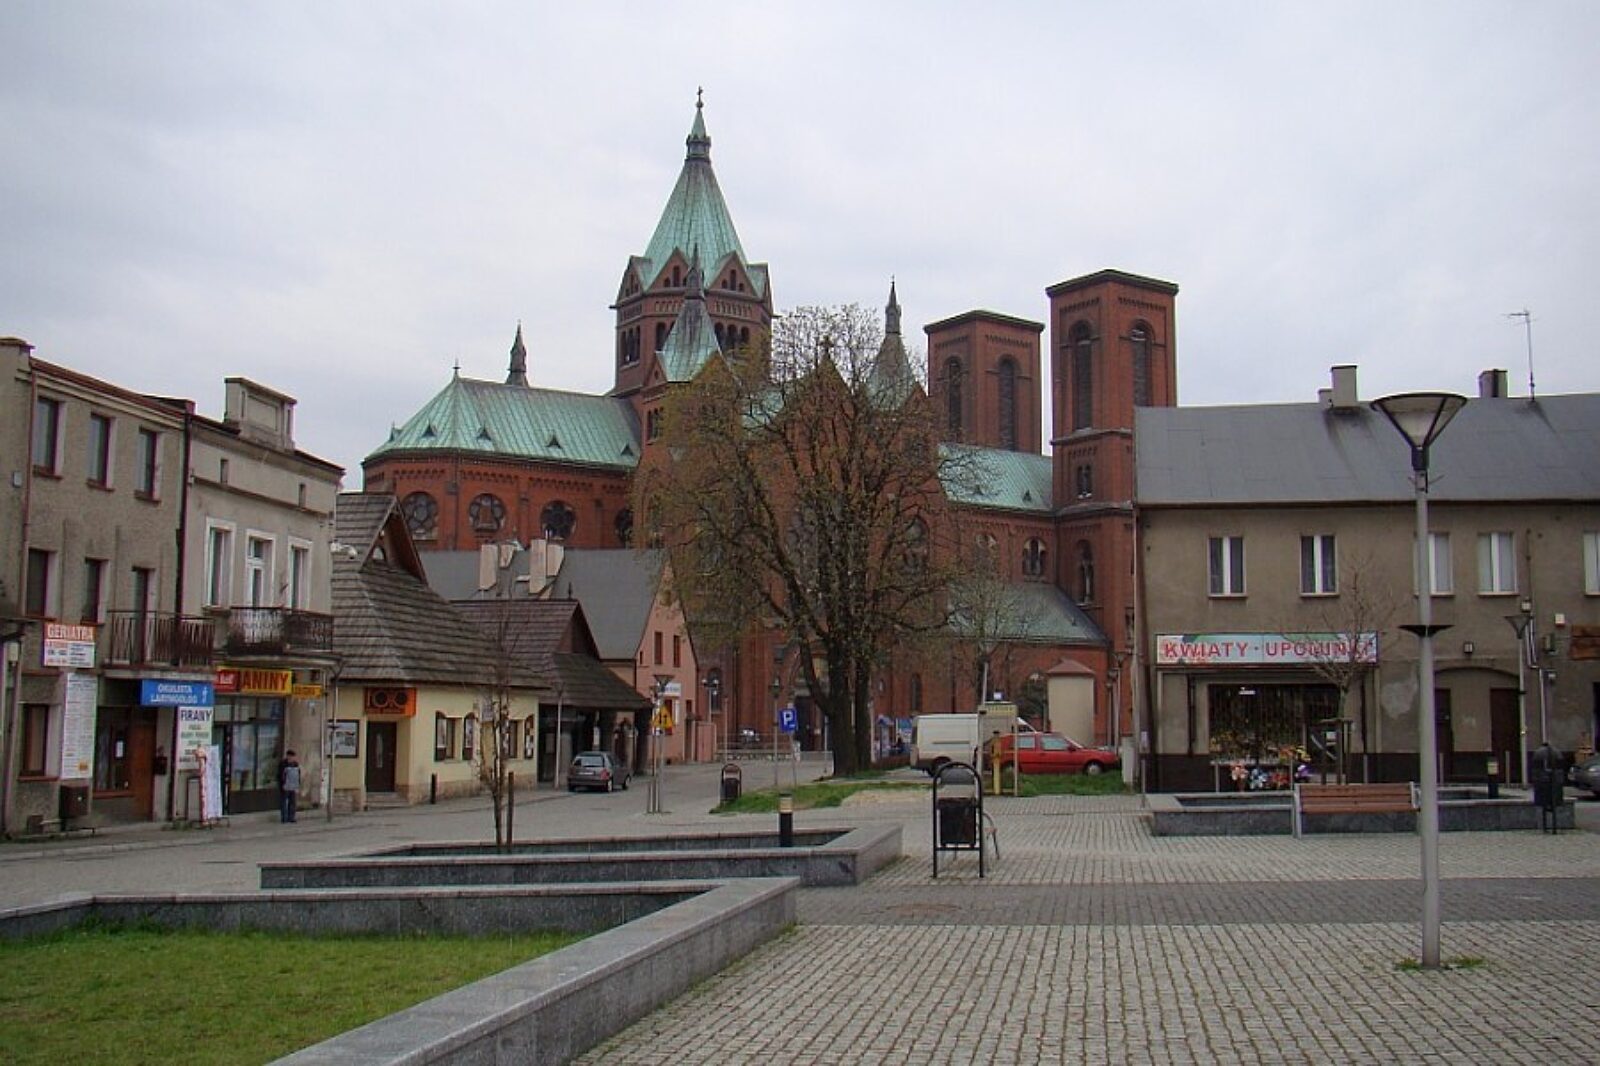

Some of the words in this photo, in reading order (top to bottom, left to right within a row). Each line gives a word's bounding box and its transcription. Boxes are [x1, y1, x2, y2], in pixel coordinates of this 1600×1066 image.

[47, 623, 94, 641] GERIATRA
[1164, 641, 1248, 657] KWIATY
[1265, 641, 1373, 657] UPOMIN
[180, 709, 212, 721] FIRANY
[783, 711, 794, 725] P
